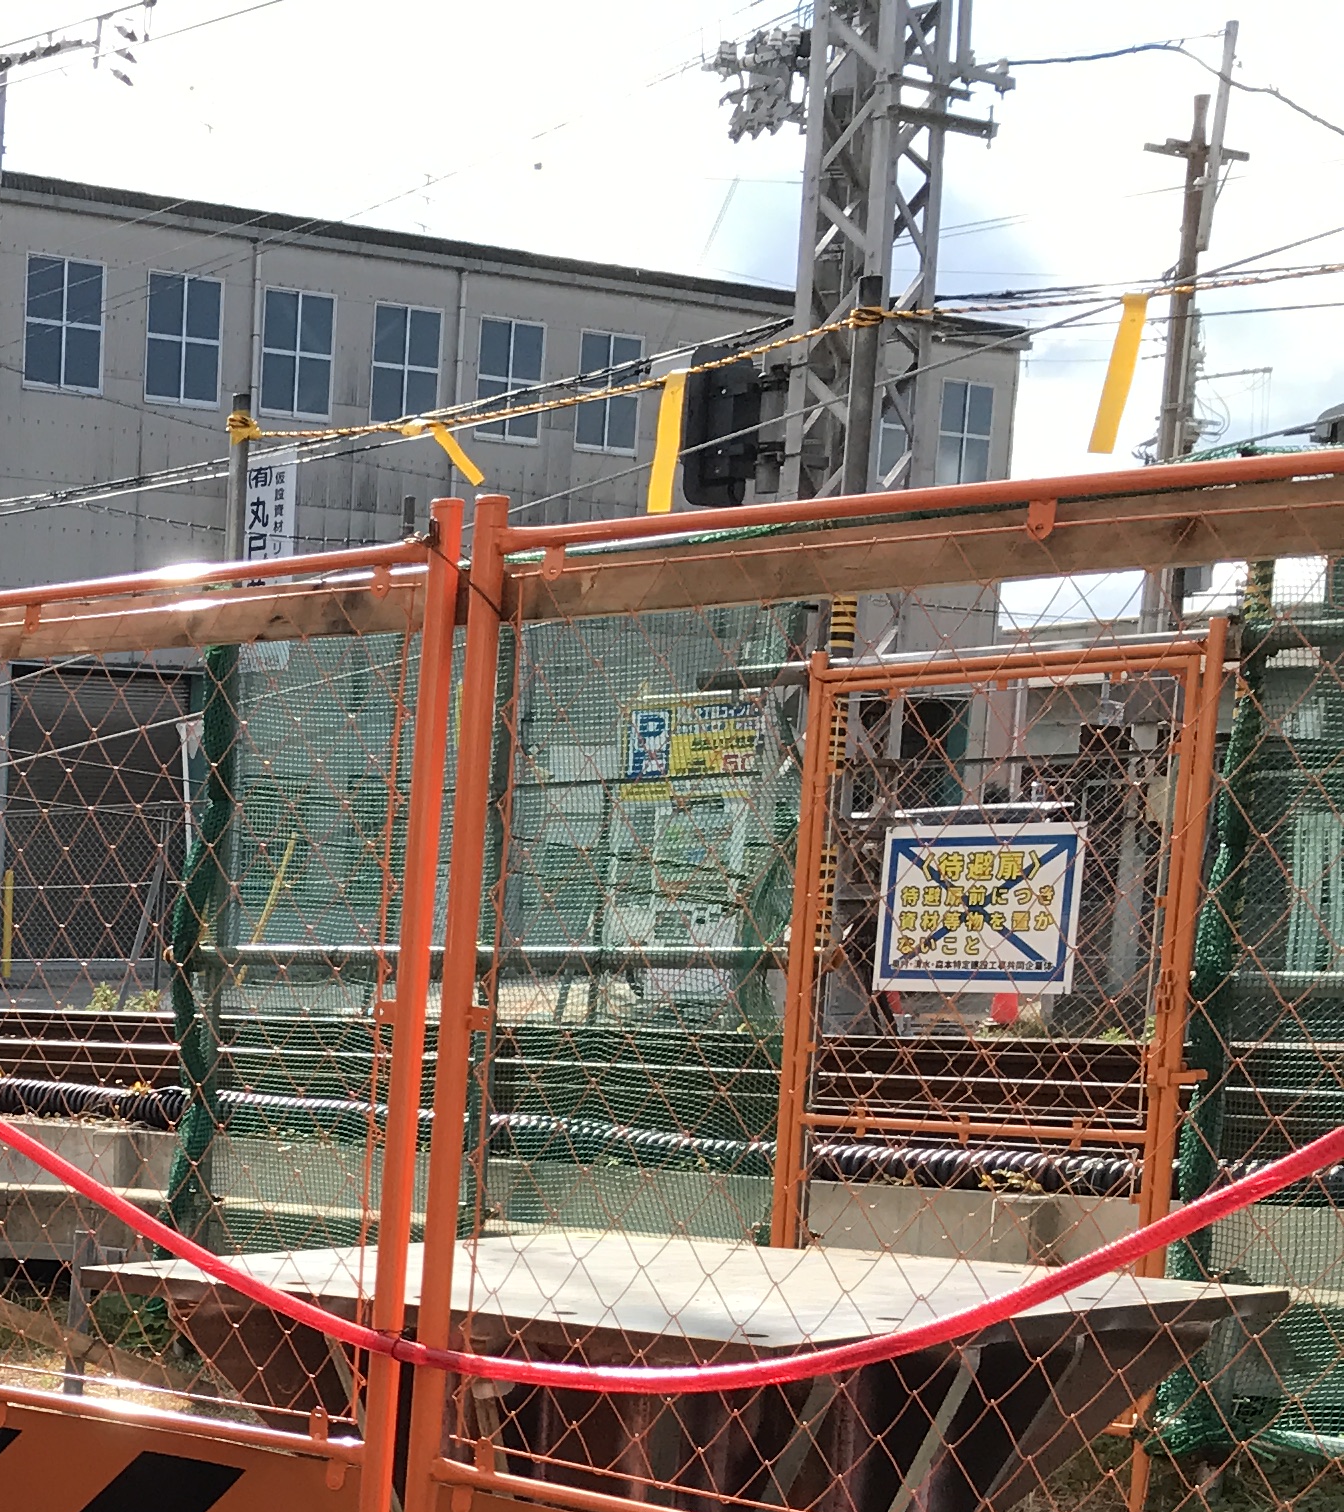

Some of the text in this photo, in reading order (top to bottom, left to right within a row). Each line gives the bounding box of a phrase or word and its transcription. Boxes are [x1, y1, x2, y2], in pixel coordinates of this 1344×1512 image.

[900, 885, 1056, 907] 待避扉前につき
[898, 912, 1055, 932] 資材等物を置か
[896, 936, 981, 955] ないこと
